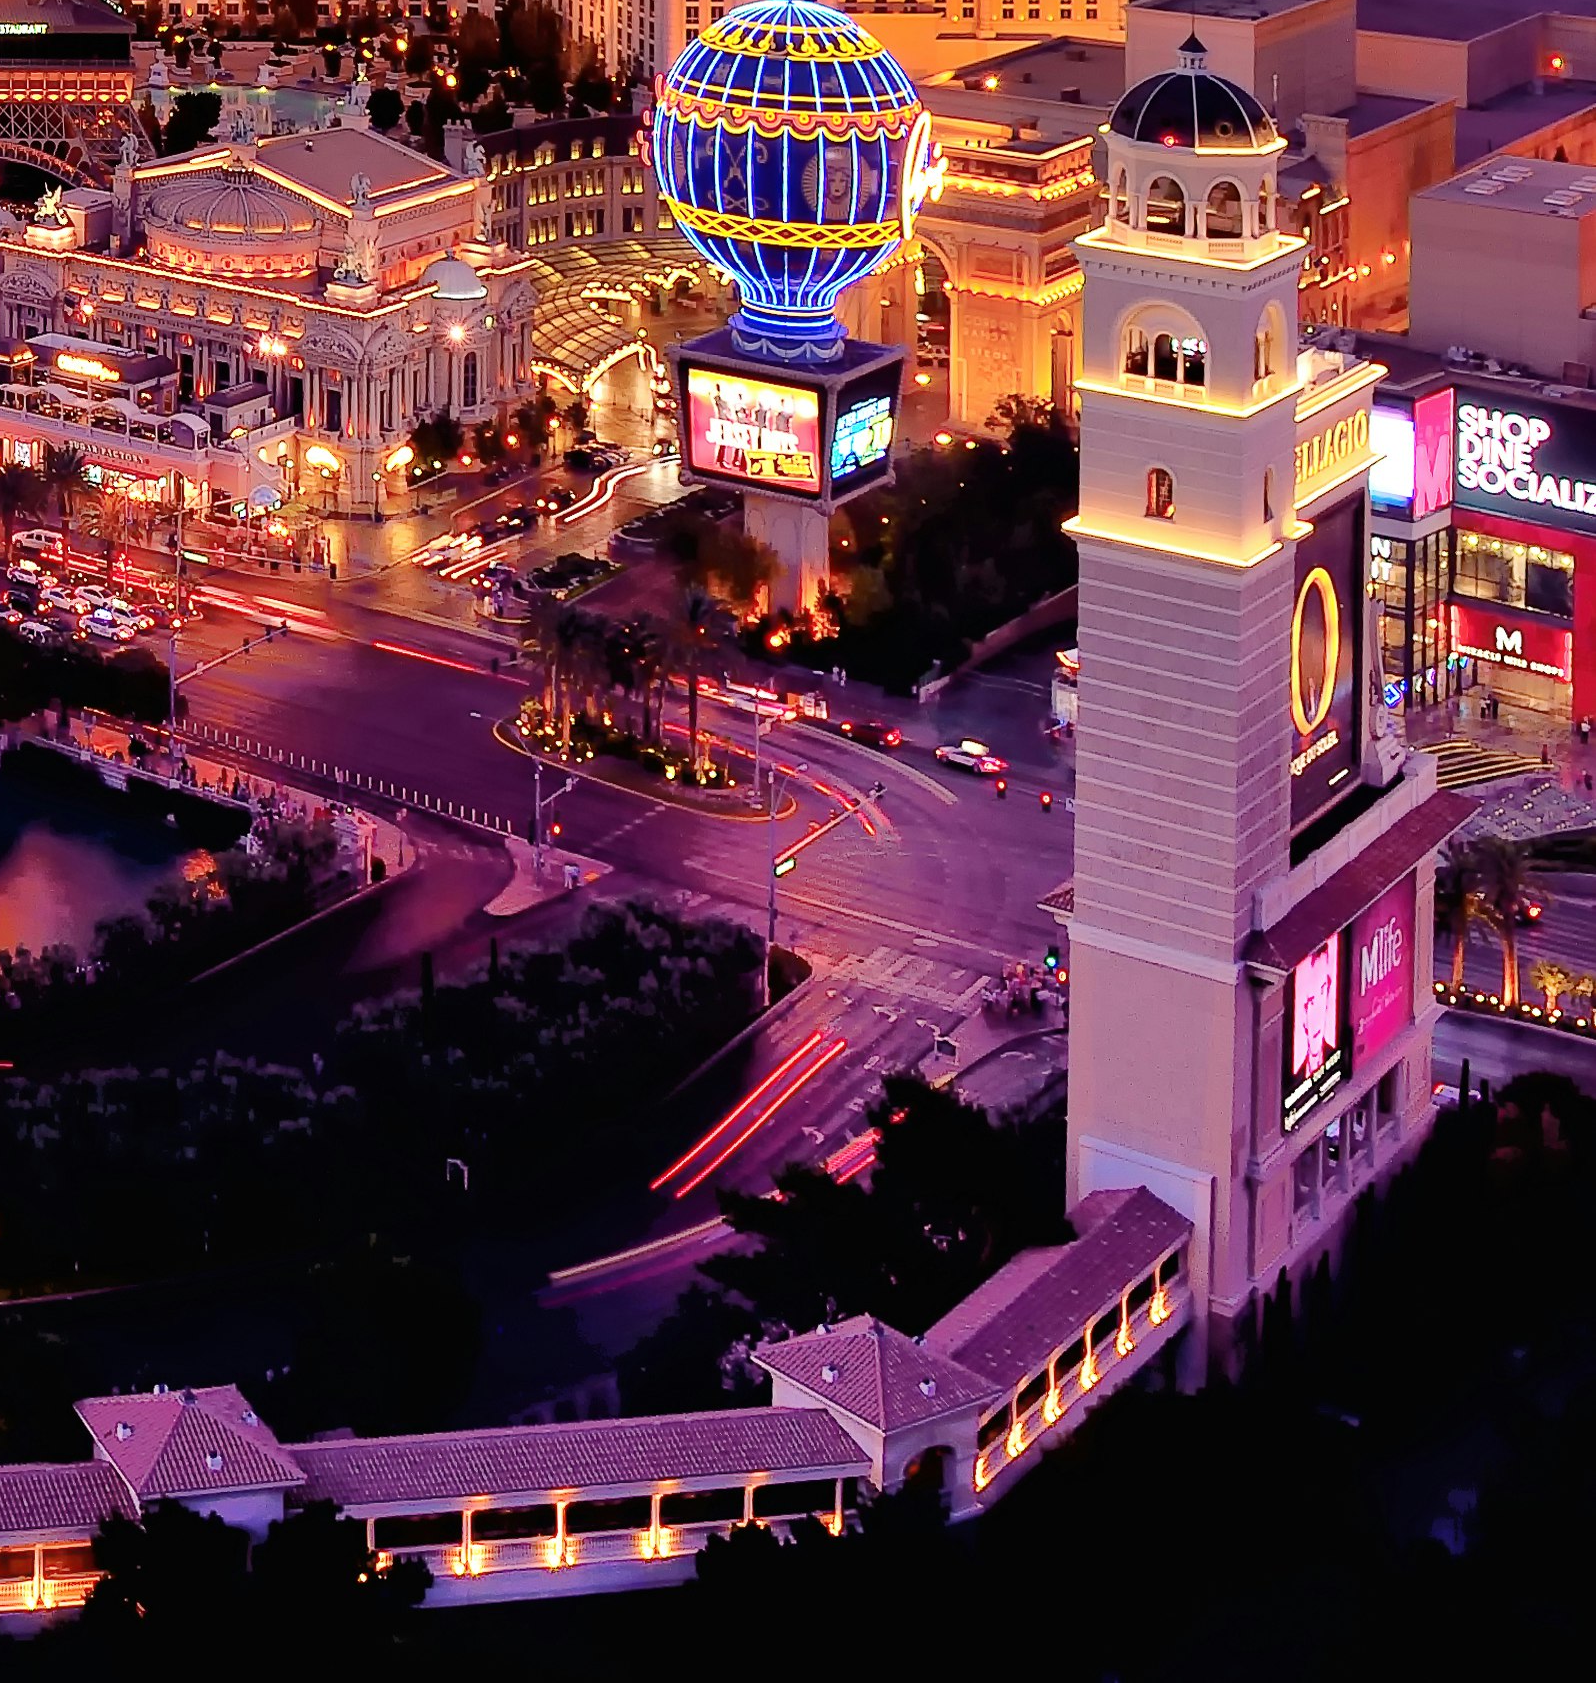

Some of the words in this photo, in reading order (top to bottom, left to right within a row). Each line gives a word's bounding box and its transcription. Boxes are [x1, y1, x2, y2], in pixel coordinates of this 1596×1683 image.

[1459, 404, 1552, 447] SHOP
[101, 446, 145, 464] FACTORY
[1459, 432, 1534, 473] DINE
[1496, 626, 1523, 654] M
